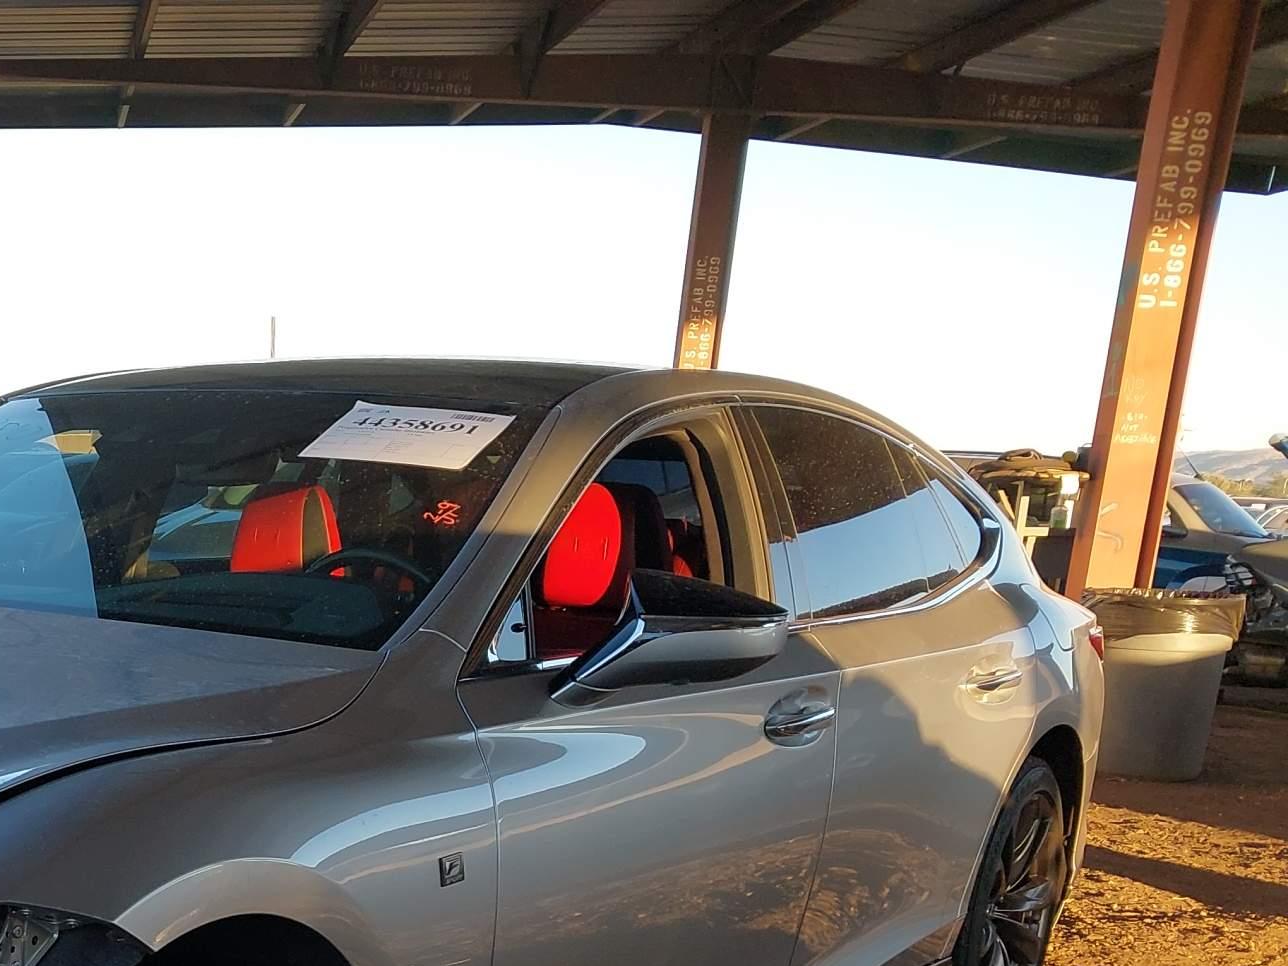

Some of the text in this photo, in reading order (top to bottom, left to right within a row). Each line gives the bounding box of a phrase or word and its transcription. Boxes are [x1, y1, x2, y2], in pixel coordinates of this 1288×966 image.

[1137, 108, 1192, 309] U.S. PREFAB INC.
[1159, 111, 1212, 308] 1-866-799-0969
[695, 255, 709, 281] INC.
[687, 287, 704, 339] PREFAB
[352, 416, 479, 435] 44358691
